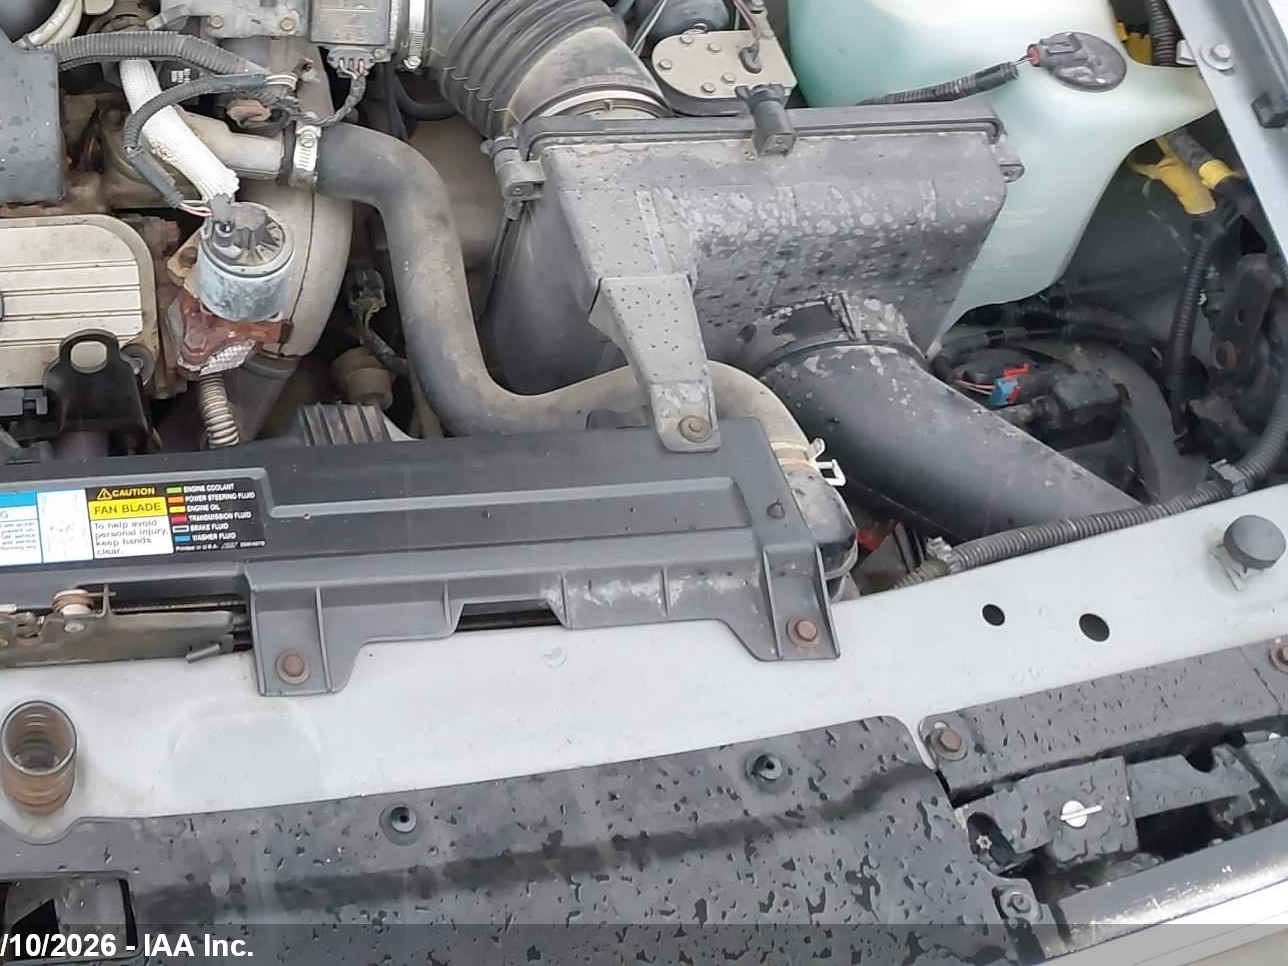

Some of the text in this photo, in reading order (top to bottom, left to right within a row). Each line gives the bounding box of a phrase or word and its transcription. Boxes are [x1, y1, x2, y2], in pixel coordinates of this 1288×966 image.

[111, 487, 155, 498] CAUTION
[183, 482, 235, 493] ENGINE COOLANT
[185, 491, 255, 502] POWER STEERING FLUID
[94, 502, 162, 516] FAN BLADE
[187, 503, 221, 512] ENGINE OIL
[189, 511, 252, 522] TRANSMISSION FLUID
[108, 521, 128, 530] help
[132, 519, 158, 528] avoid
[190, 522, 229, 532] BRAKE FLUID
[95, 529, 136, 539] personal
[192, 532, 236, 541] WASHER FLUID
[96, 537, 152, 547] keep hands
